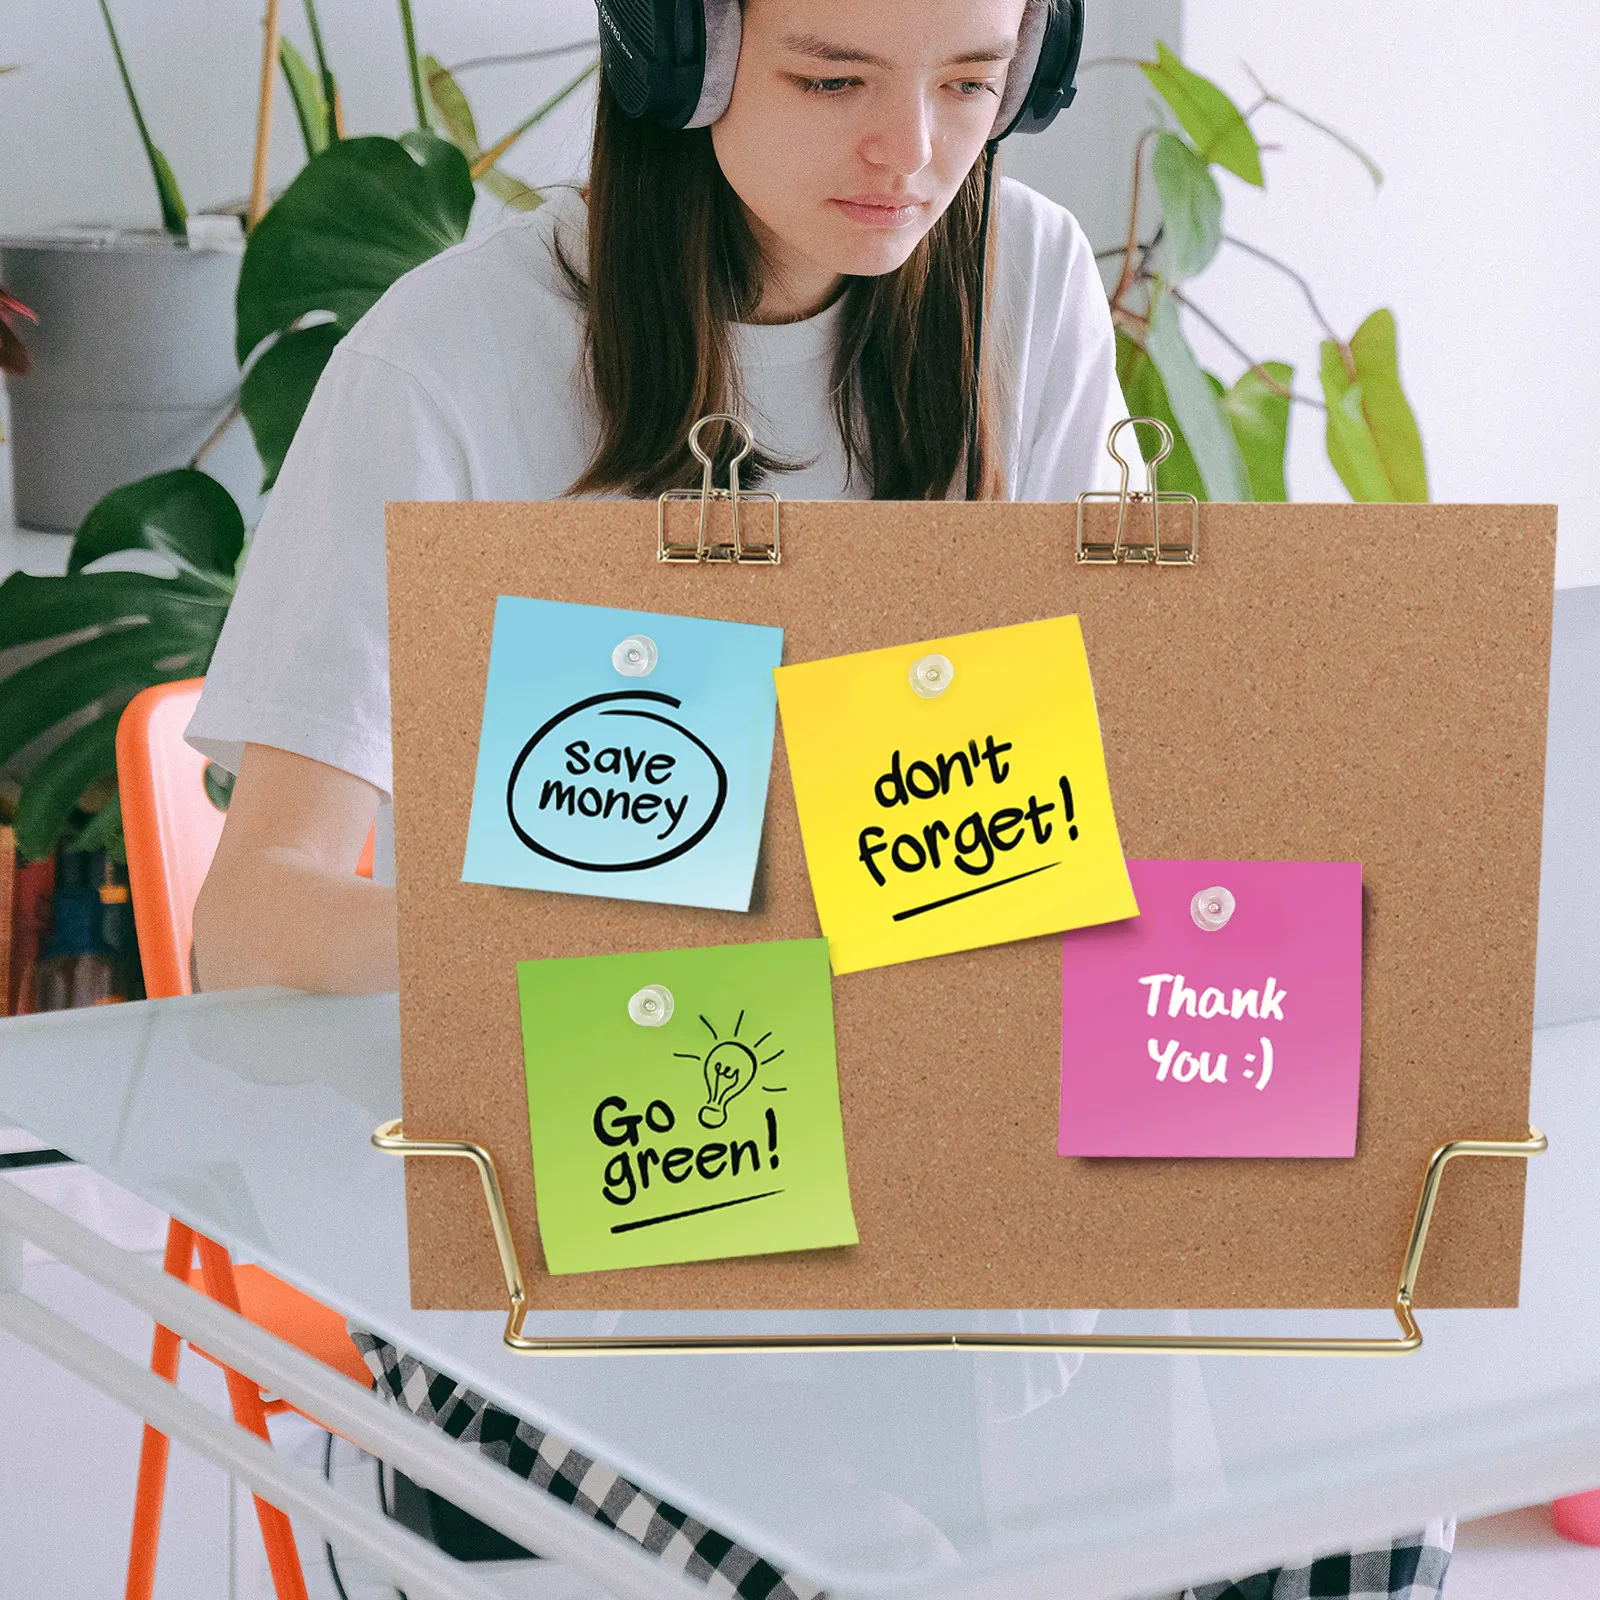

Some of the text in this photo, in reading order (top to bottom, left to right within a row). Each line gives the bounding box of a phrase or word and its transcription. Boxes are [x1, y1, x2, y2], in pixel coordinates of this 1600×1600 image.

[564, 740, 676, 785] save
[874, 735, 1013, 808] don't
[538, 779, 689, 840] money
[858, 775, 1079, 887] forget!
[1138, 973, 1287, 1021] Thank
[1147, 1038, 1228, 1084] You
[593, 1095, 676, 1147] Go
[602, 1107, 780, 1206] green!
